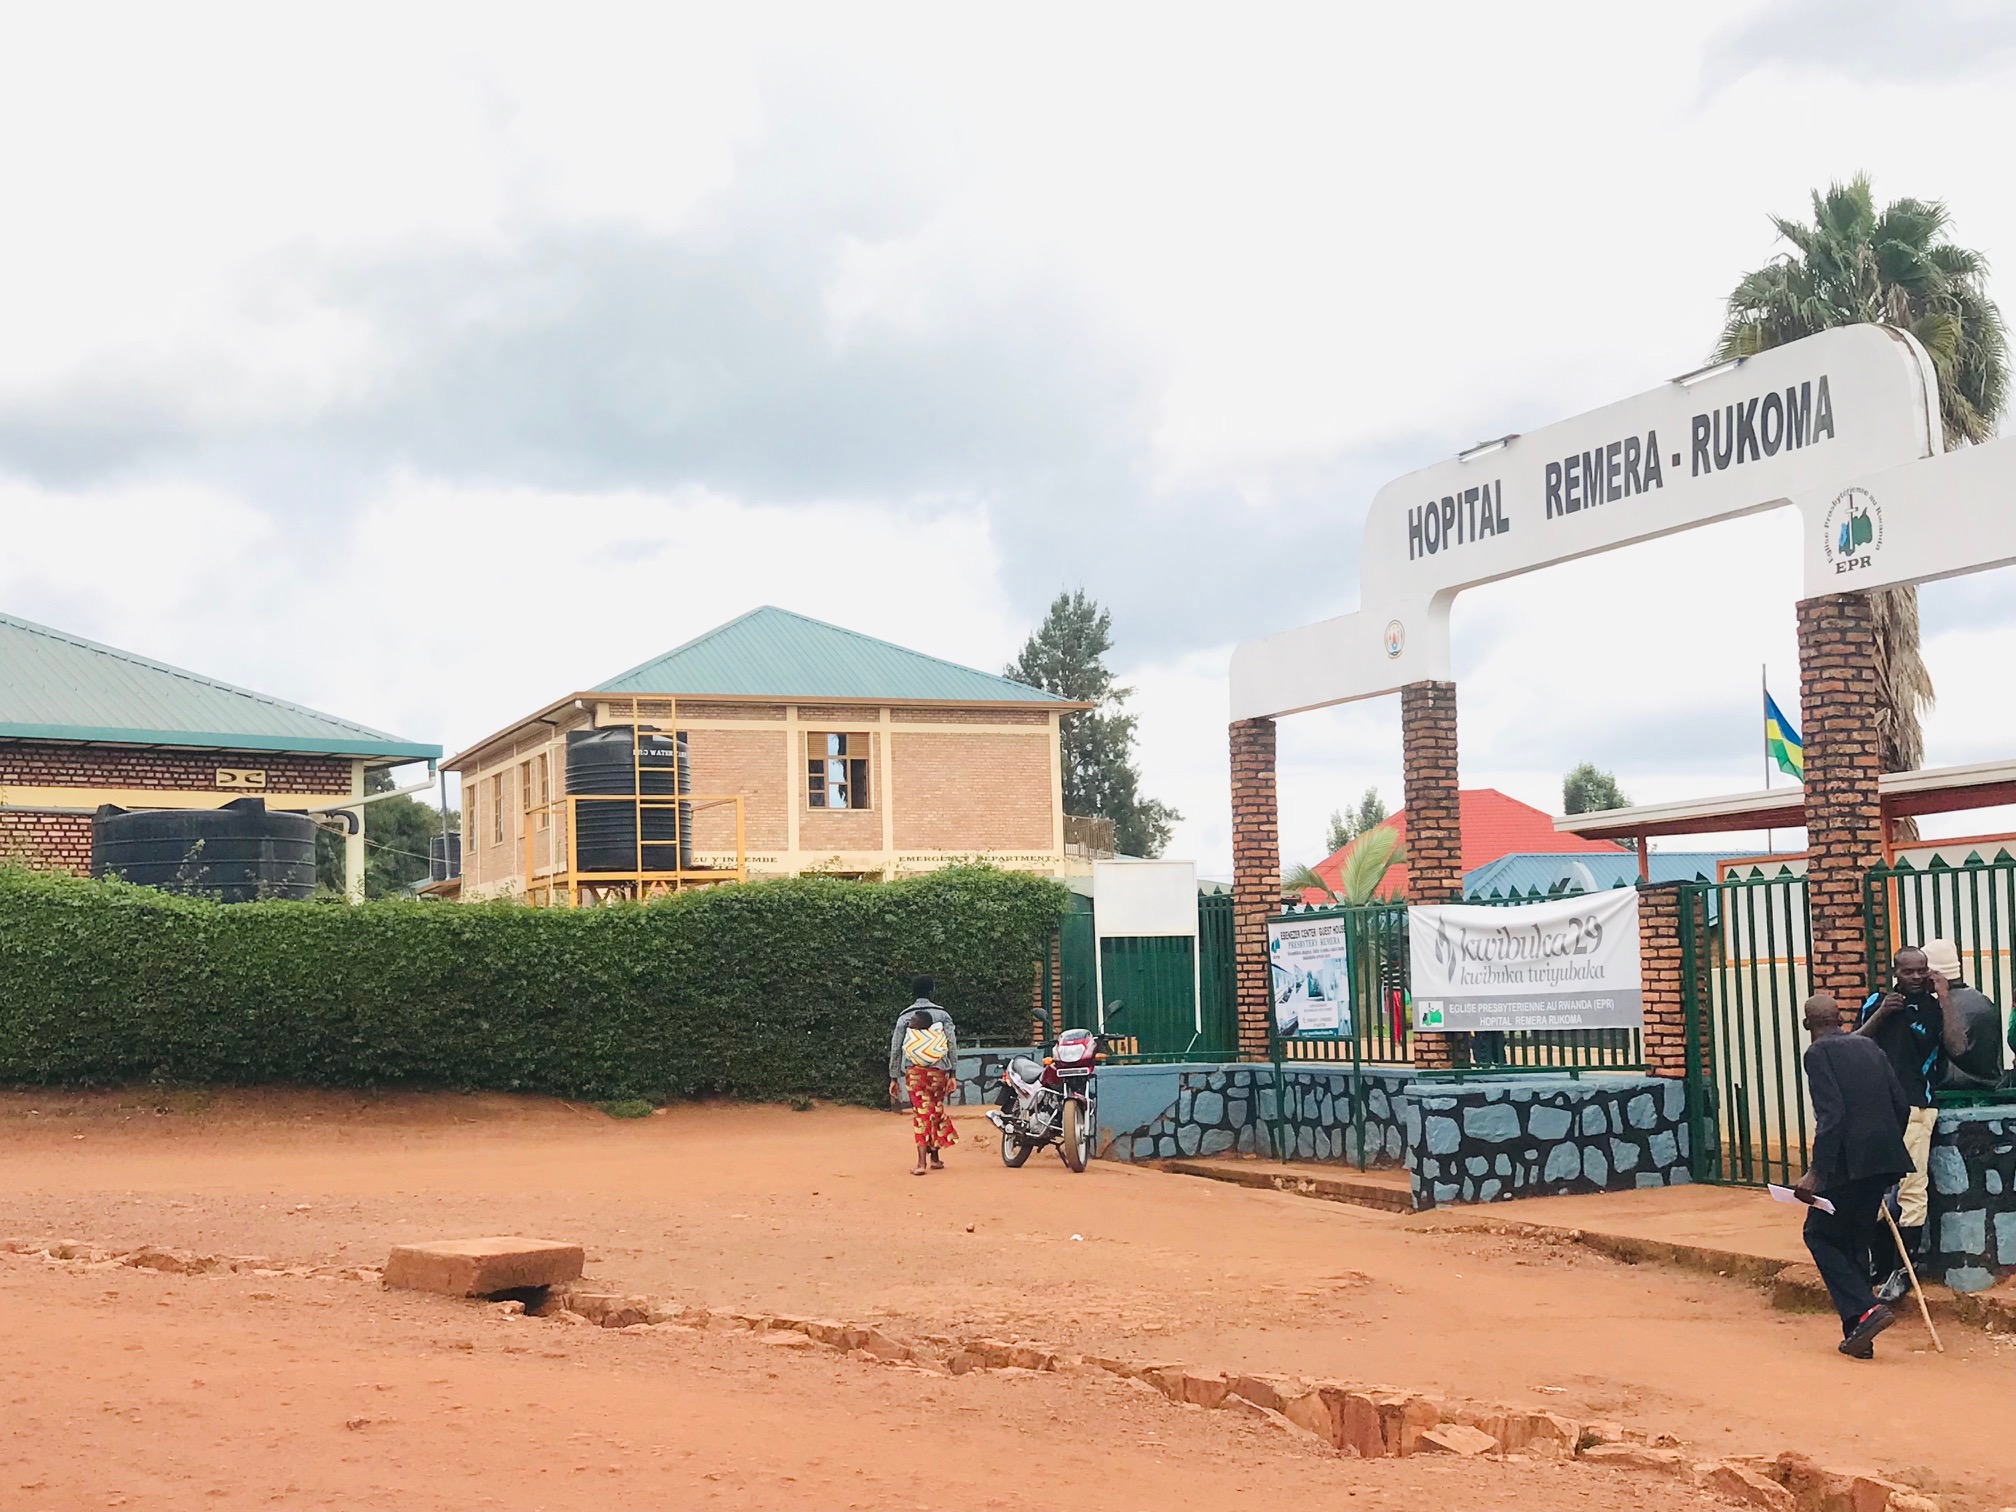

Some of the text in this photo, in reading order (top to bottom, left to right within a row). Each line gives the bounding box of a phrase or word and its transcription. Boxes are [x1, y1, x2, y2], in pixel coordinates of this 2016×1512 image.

[1408, 479, 1510, 561] HOPITAL
[1545, 430, 1663, 520] REMERA
[1691, 374, 1835, 478] RUKOMA
[1835, 555, 1872, 574] EPR
[1460, 960, 1606, 987] kwibuka twiyubaka
[1449, 998, 1615, 1014] EGLISE PRESBYTERIENNE AU RWANDA (EPR)
[1479, 1014, 1582, 1026] HOPITAL REMERA RUKOMA
